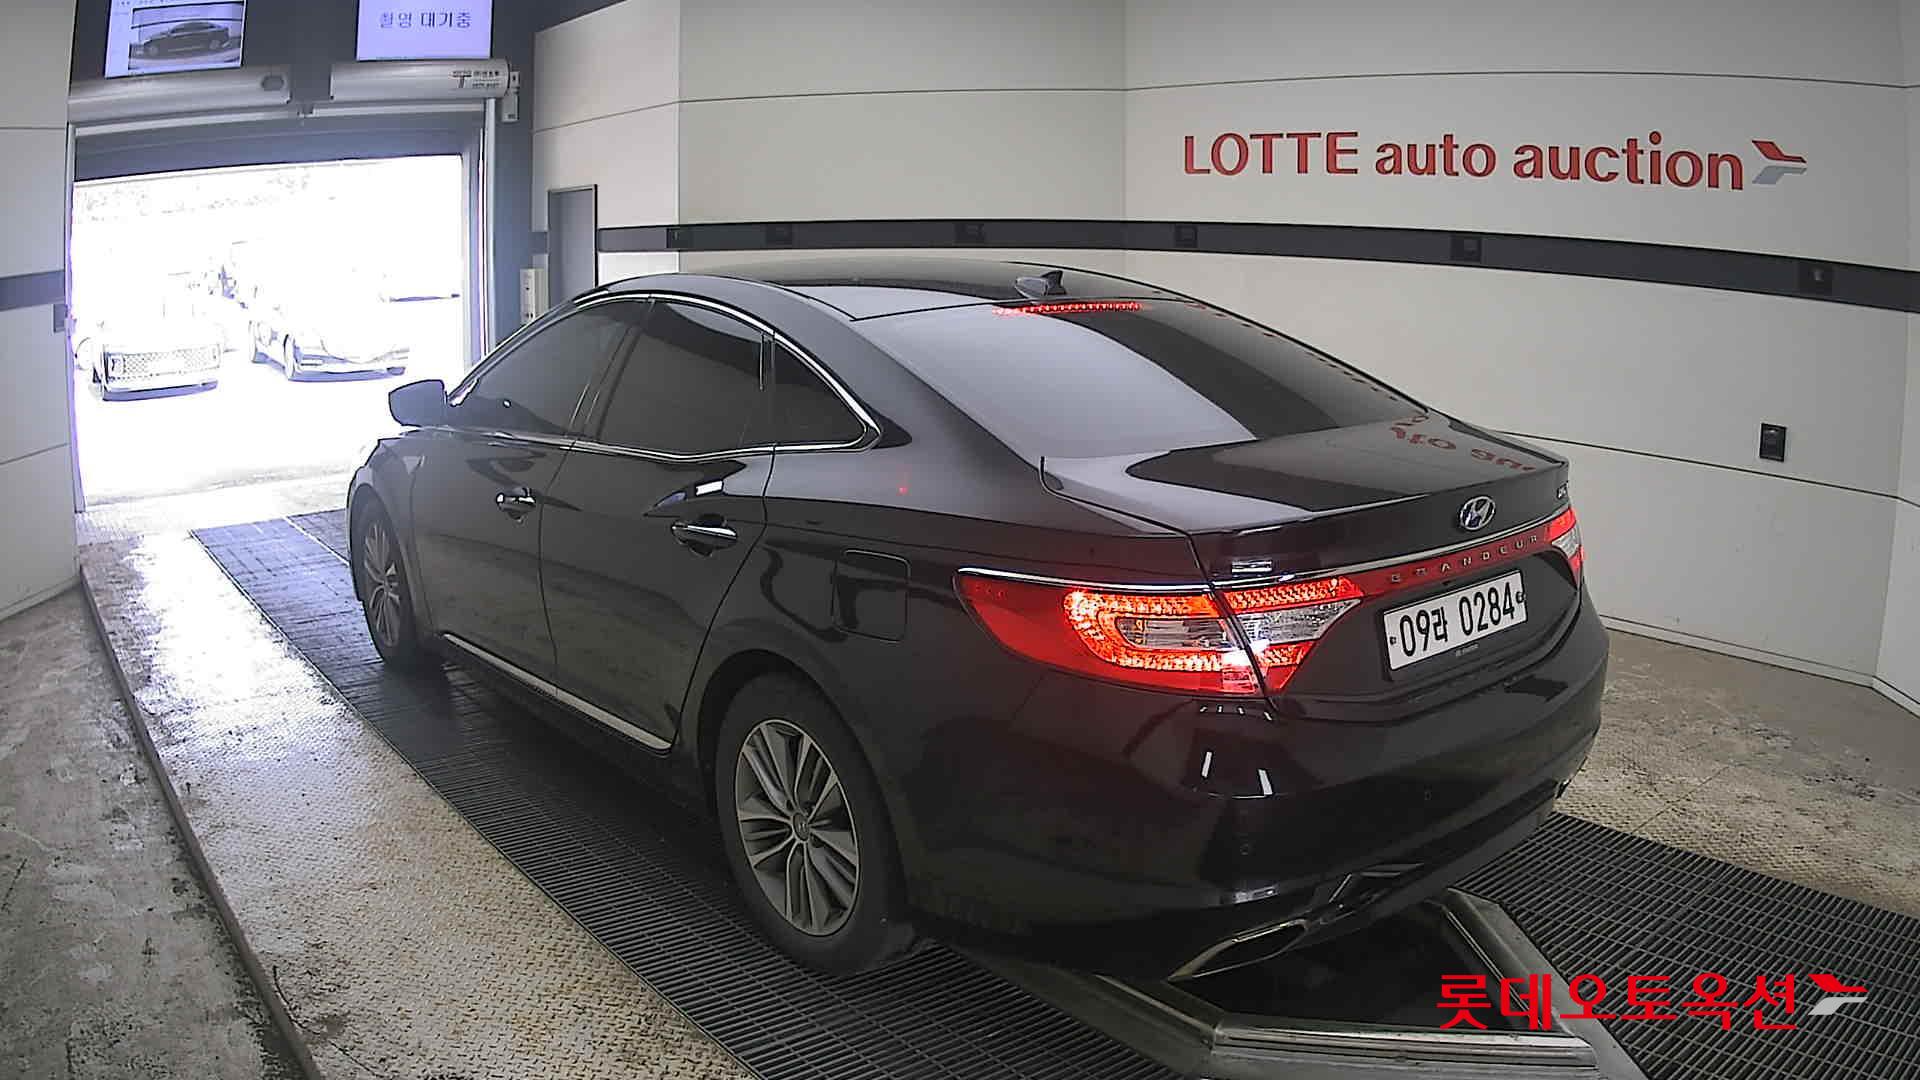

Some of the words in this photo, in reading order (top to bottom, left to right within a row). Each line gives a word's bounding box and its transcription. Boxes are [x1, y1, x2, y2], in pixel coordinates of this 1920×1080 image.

[420, 12, 471, 28] 대기중
[1184, 131, 1358, 176] LOTTE
[1375, 134, 1496, 178] auto
[1513, 132, 1743, 190] auction
[1391, 535, 1538, 582] GRANDEUR
[1400, 607, 1448, 657] 09라
[1459, 582, 1515, 636] 0284
